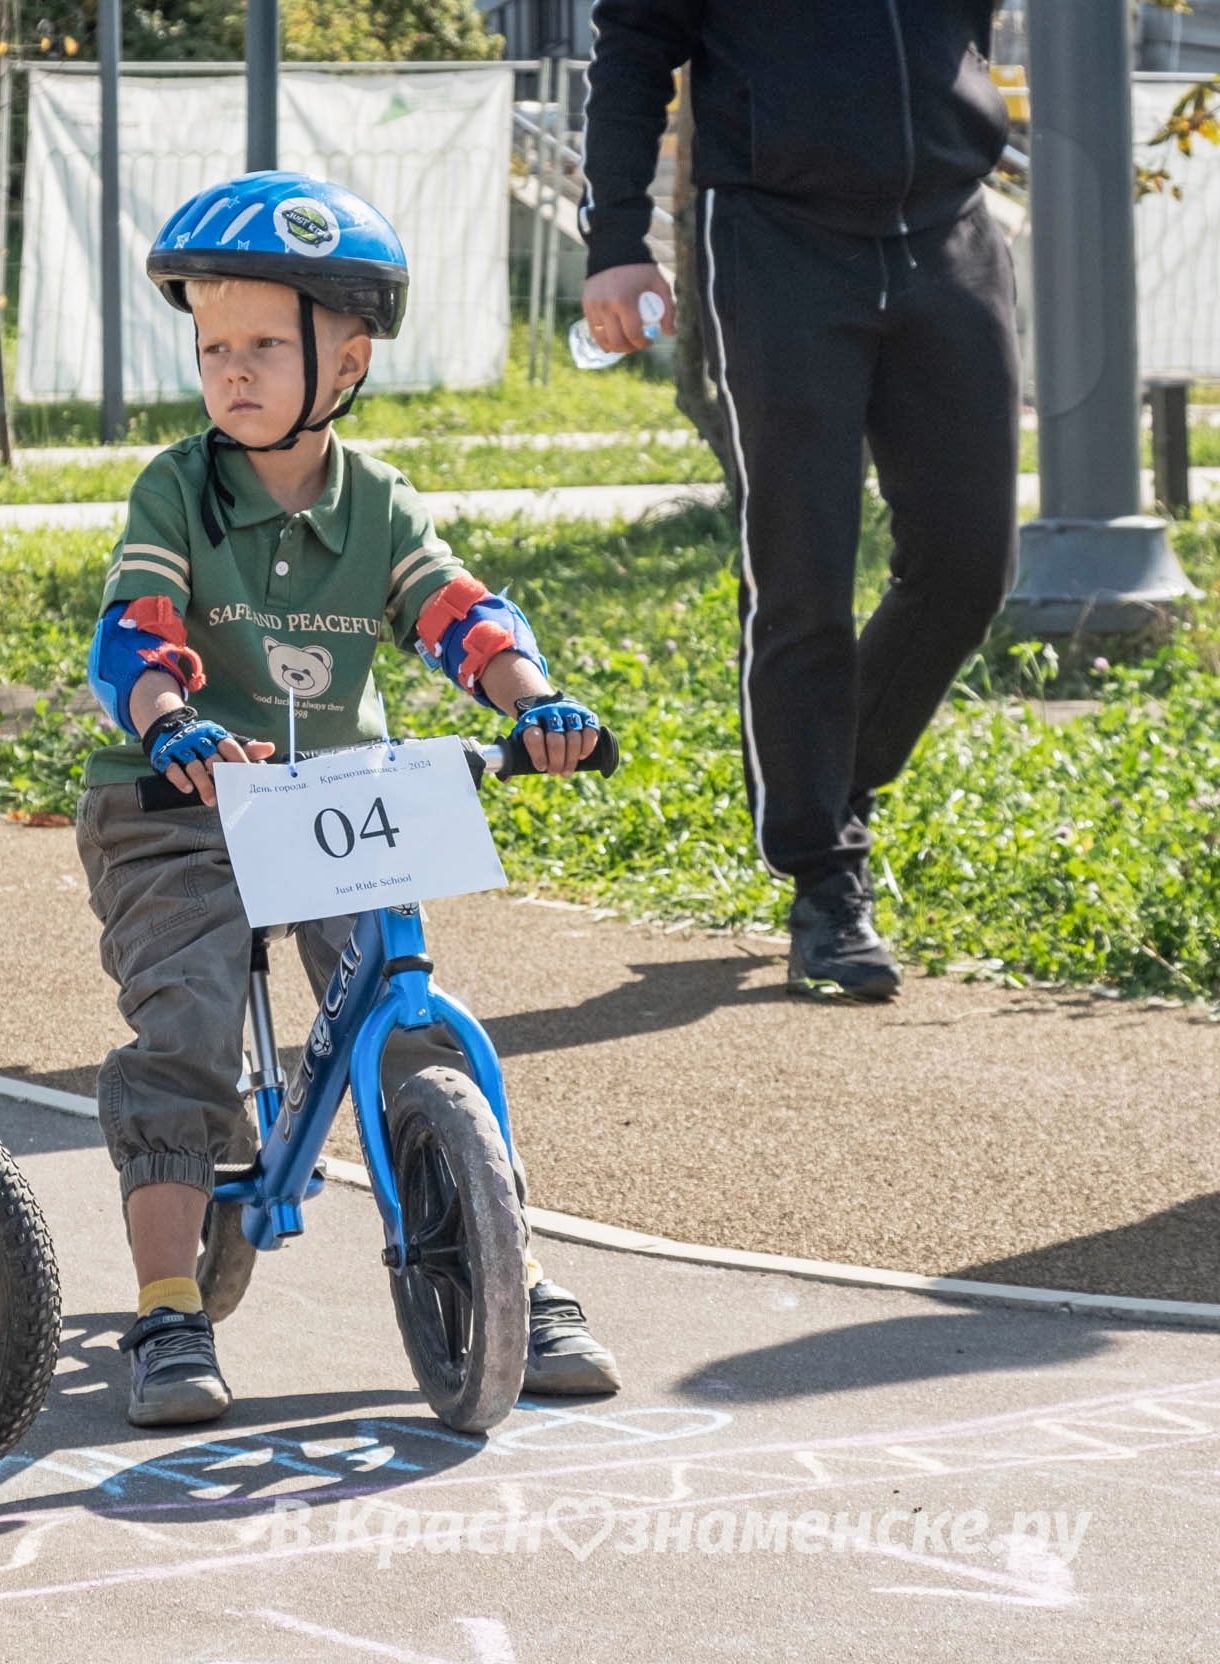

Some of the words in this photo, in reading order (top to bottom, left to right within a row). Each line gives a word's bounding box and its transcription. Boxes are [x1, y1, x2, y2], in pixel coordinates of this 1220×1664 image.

[252, 611, 282, 630] AND
[408, 759, 432, 771] 2024
[313, 796, 400, 859] 04
[334, 883, 353, 896] Just
[355, 879, 378, 891] Ride
[380, 874, 412, 888] School
